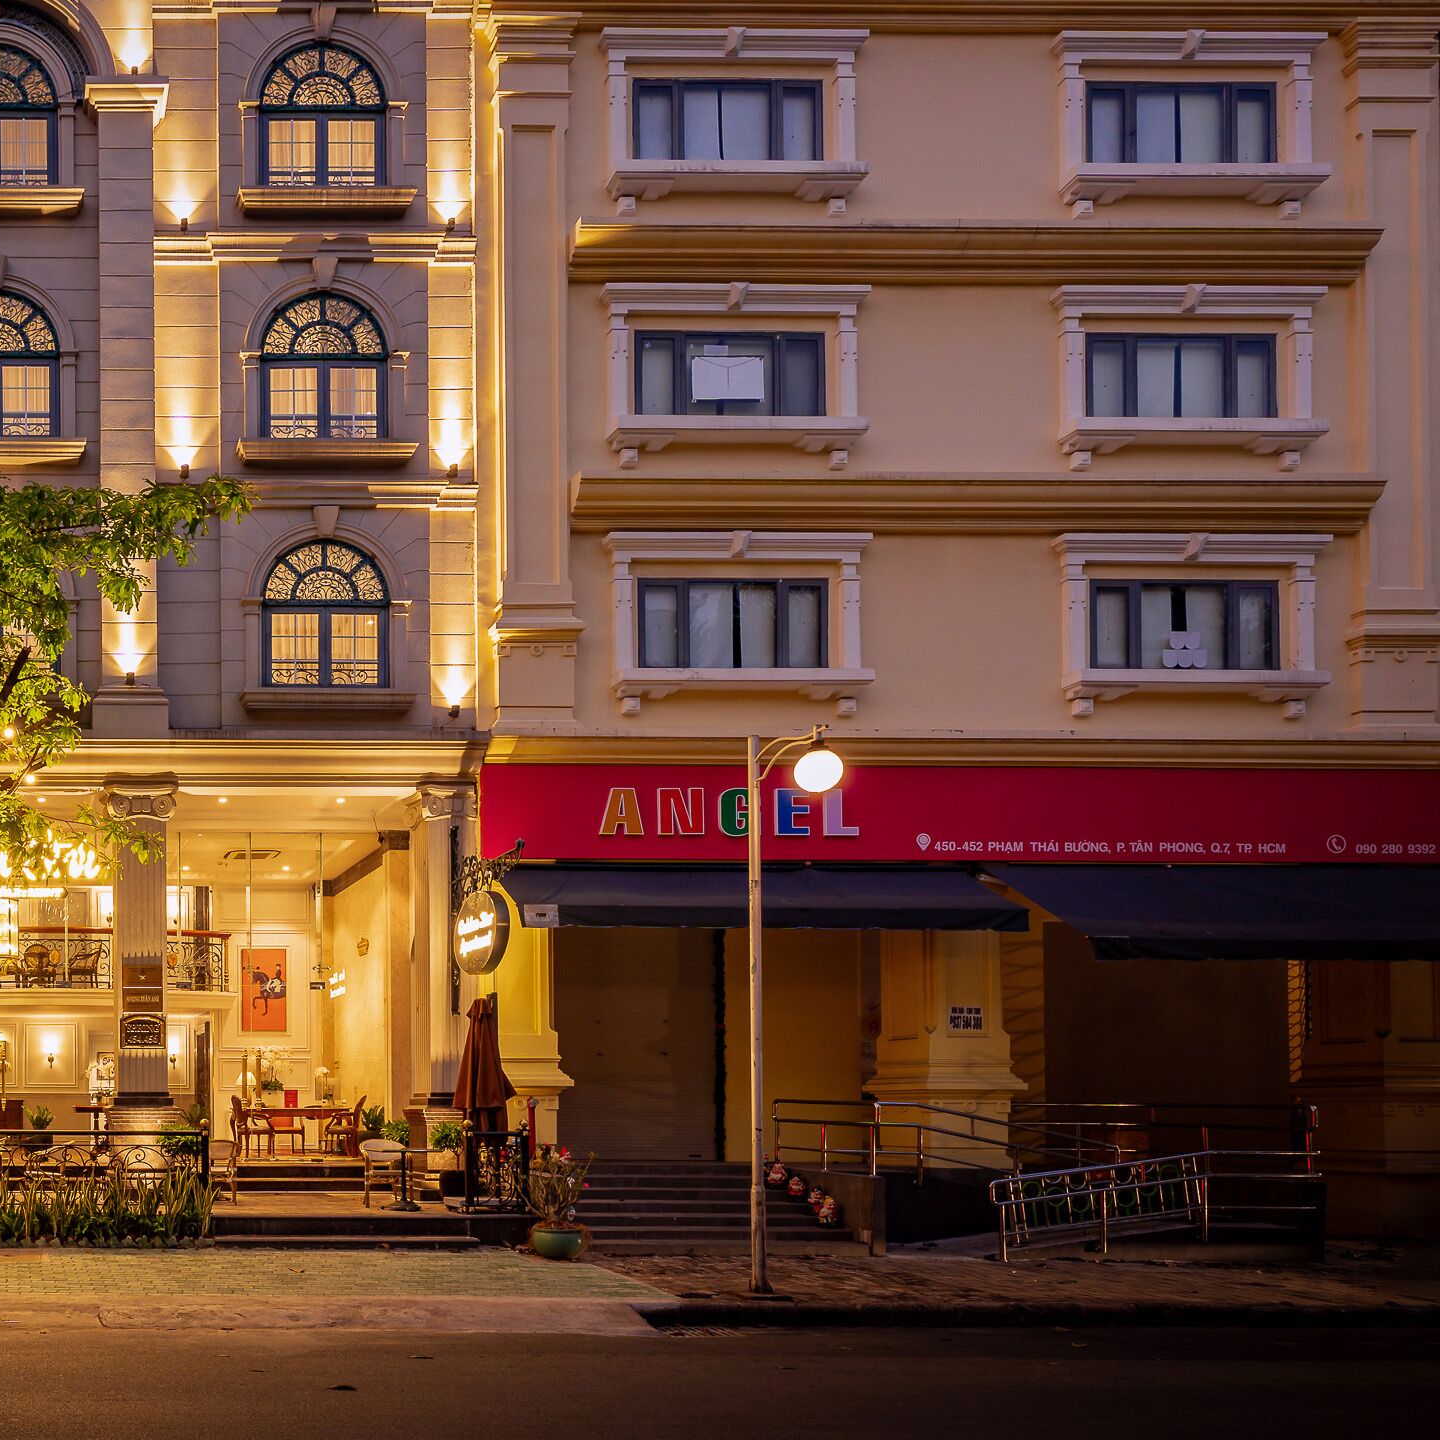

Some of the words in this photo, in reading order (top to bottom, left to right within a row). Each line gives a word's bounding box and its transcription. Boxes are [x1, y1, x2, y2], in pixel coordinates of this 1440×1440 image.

[598, 787, 860, 837] ANGEL
[934, 841, 983, 852] 450-452
[988, 841, 1024, 855] PHẠM
[1030, 839, 1059, 852] THÁI
[1117, 842, 1126, 852] P.
[1129, 840, 1153, 852] TÂN
[1160, 842, 1206, 854] PHONG,
[1258, 843, 1286, 854] HCM
[1355, 844, 1377, 855] 090
[1381, 844, 1403, 855] 280
[1408, 844, 1437, 855] 9392
[126, 1024, 159, 1033] SPRING
